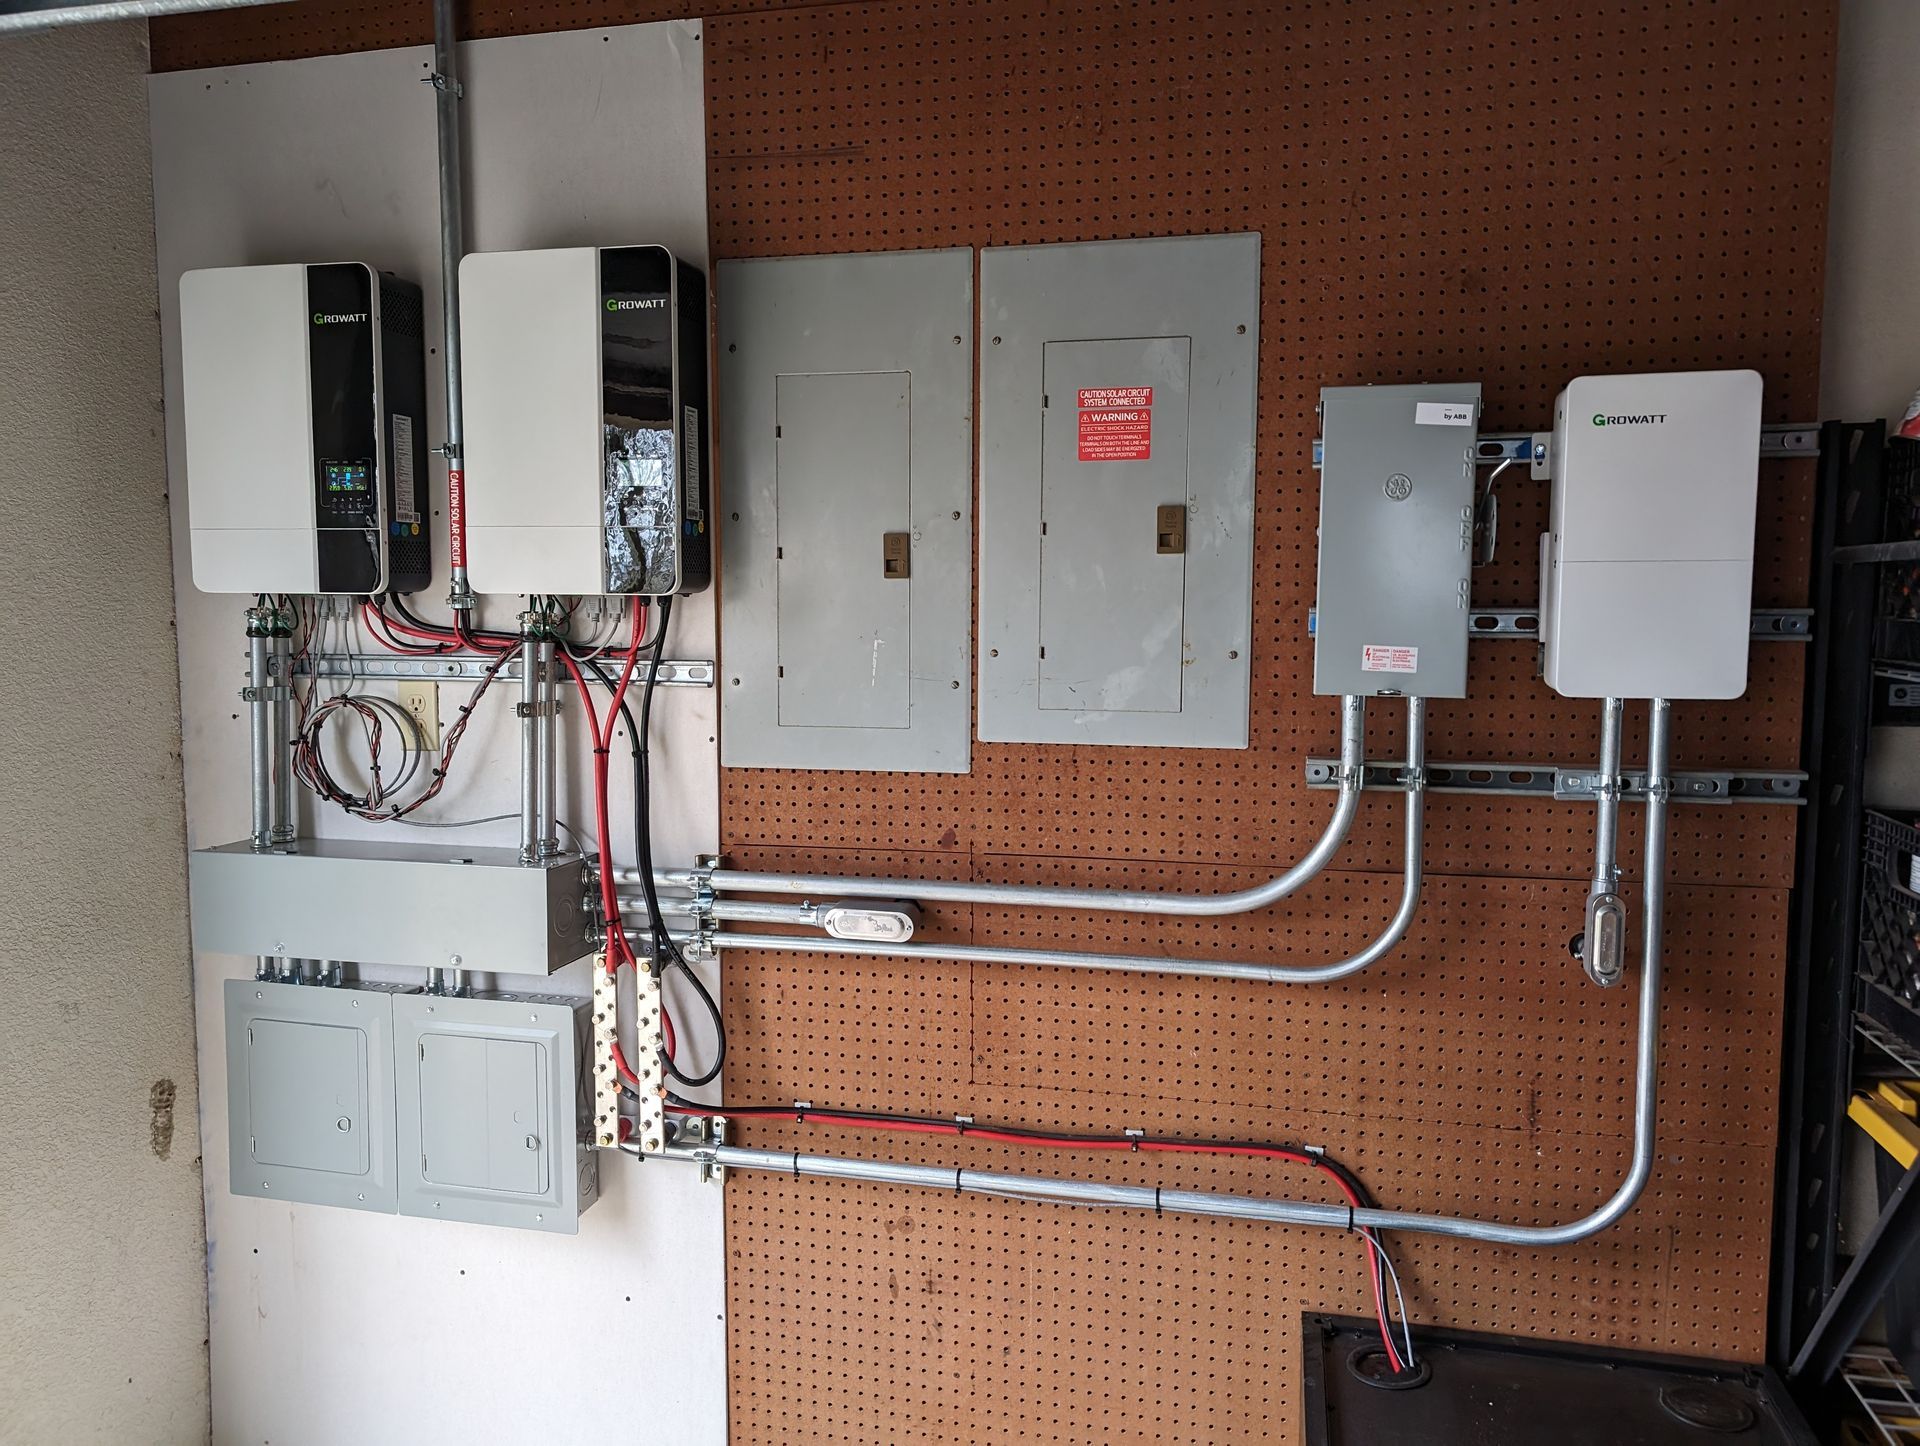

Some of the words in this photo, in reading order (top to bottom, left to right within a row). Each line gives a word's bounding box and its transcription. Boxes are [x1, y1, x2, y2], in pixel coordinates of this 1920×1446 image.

[606, 299, 667, 311] GROWATT
[313, 313, 368, 325] GROWATT
[1080, 390, 1106, 399] CAUTION
[1107, 389, 1127, 398] SOLAR
[1127, 388, 1150, 397] CIRCUIT
[1084, 398, 1107, 407] SYSTEM
[1109, 397, 1146, 406] CONNECTED
[1091, 412, 1138, 422] WARNING
[1592, 414, 1668, 426] GROWATT
[1462, 447, 1474, 478] ON
[449, 472, 459, 507] CAUTION
[451, 508, 460, 534] SOLAR
[1460, 505, 1472, 551] OFF
[452, 535, 461, 565] CIRCUIT
[1457, 578, 1469, 609] ON
